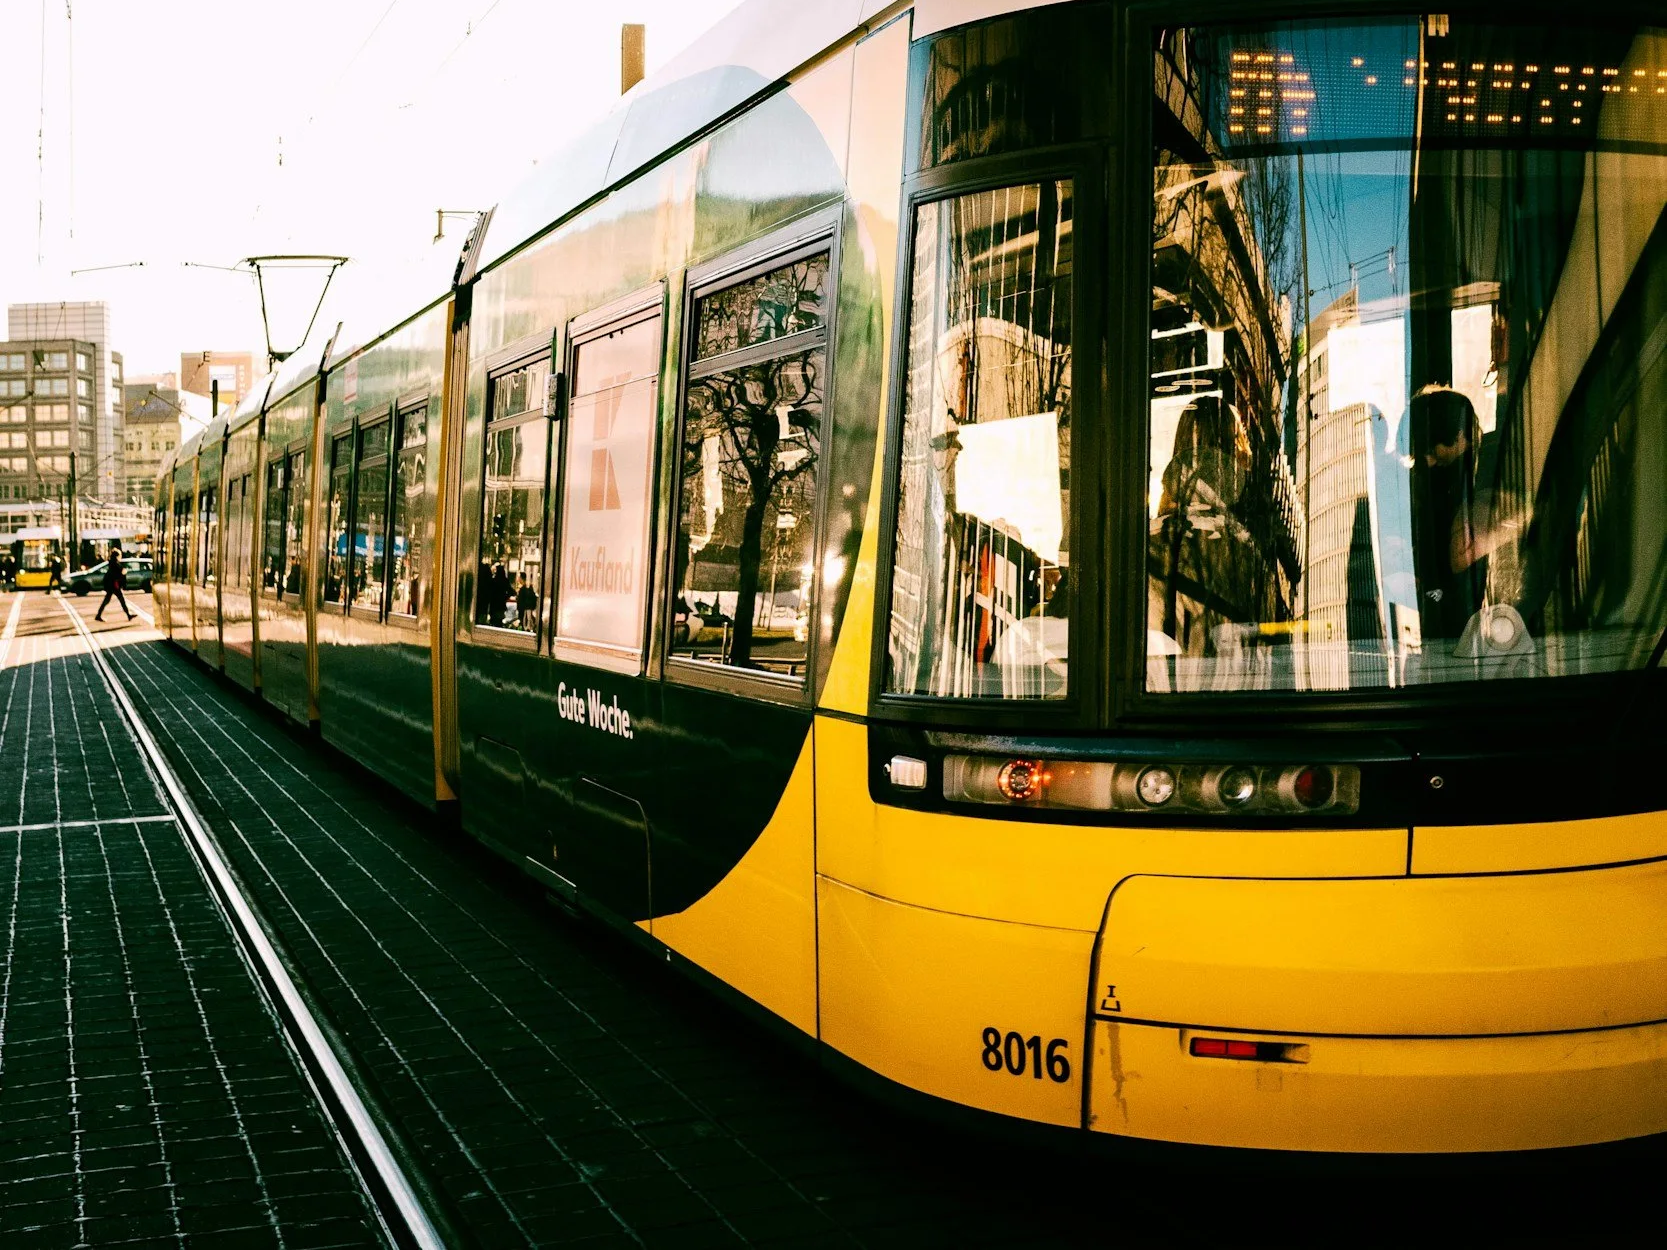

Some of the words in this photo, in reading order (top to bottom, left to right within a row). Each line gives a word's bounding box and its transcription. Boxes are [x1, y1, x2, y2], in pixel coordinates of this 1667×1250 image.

[569, 545, 634, 595] Kaufland
[557, 681, 585, 725] Gute
[587, 688, 633, 740] Woche.
[981, 1026, 1071, 1084] 8016
